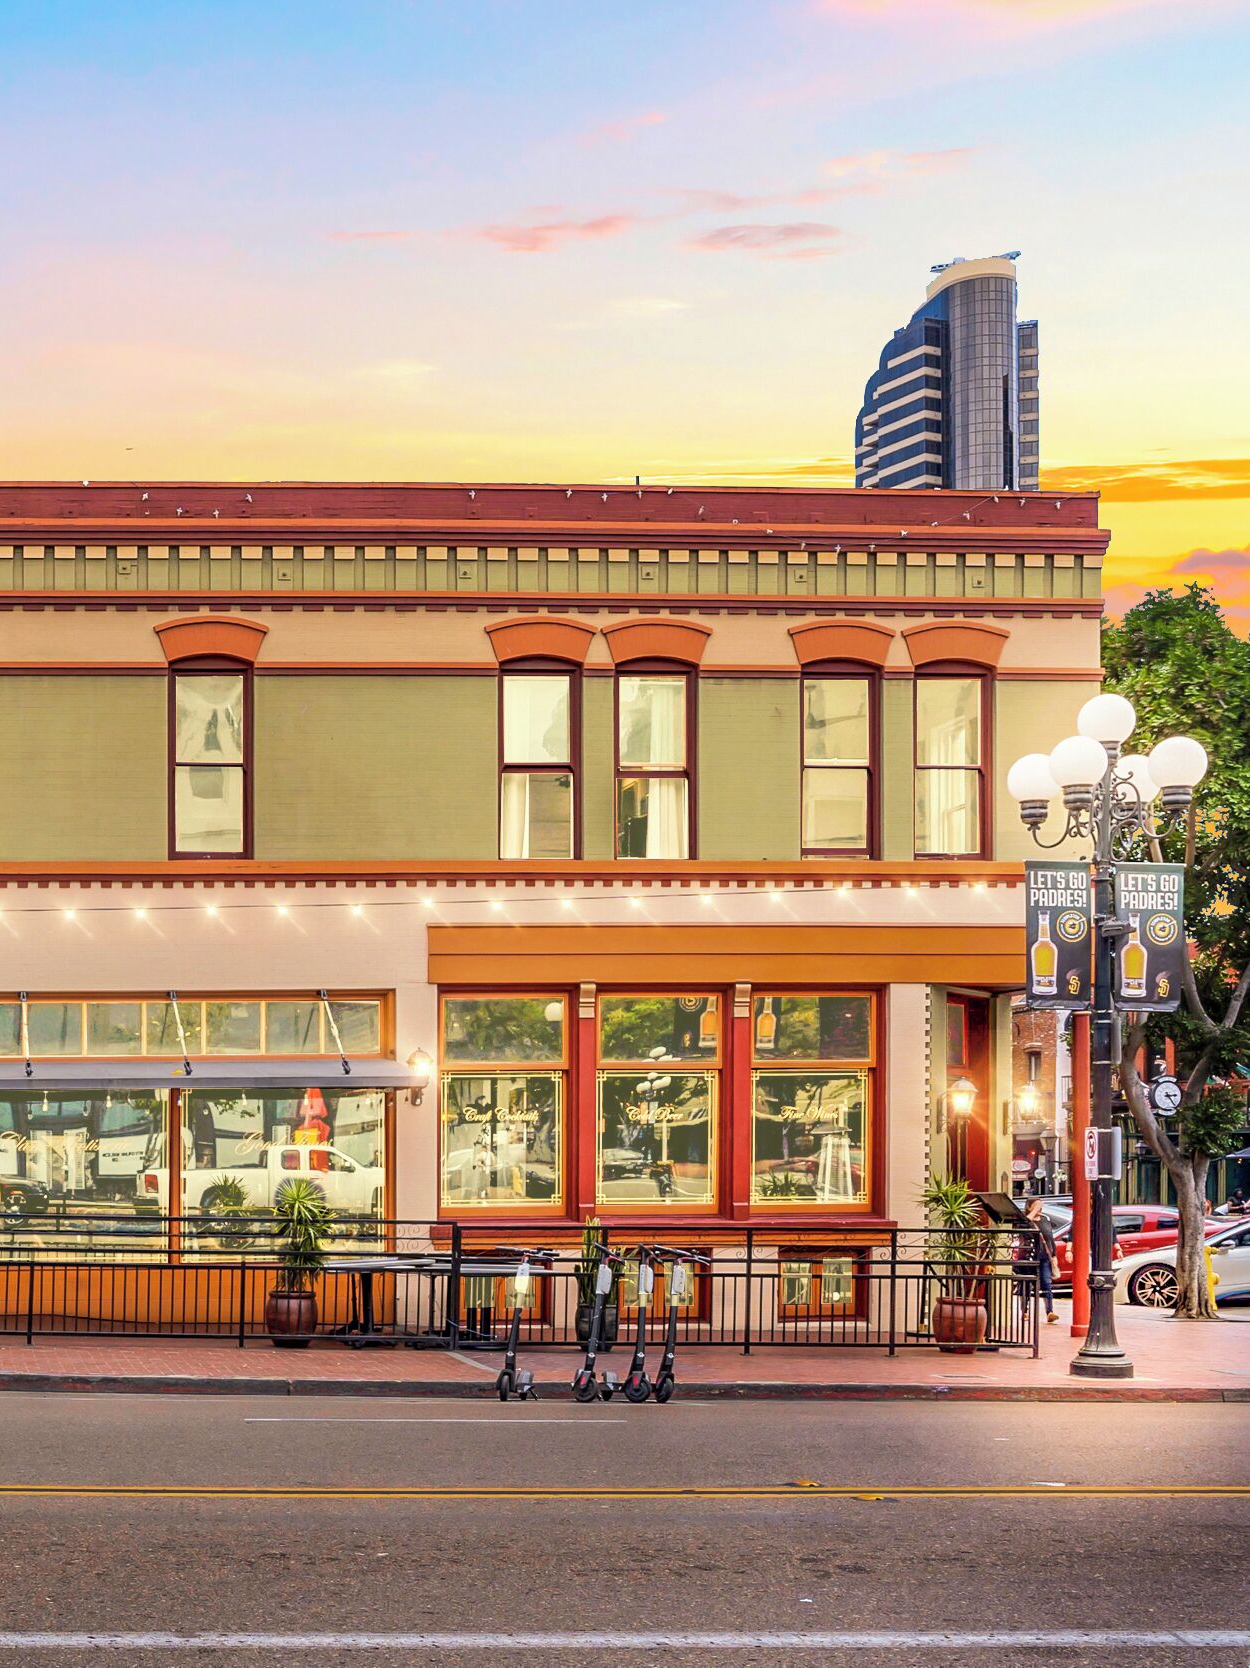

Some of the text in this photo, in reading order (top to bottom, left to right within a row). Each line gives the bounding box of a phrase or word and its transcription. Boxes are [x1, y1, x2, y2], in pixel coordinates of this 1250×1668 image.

[1030, 871, 1087, 889] LET'S GO
[1120, 873, 1178, 892] LET'S GO
[1030, 889, 1087, 908] PADRES!
[1121, 892, 1178, 910] PADRES!
[463, 1106, 539, 1125] Craft Cocktails
[654, 1106, 684, 1121] Beer
